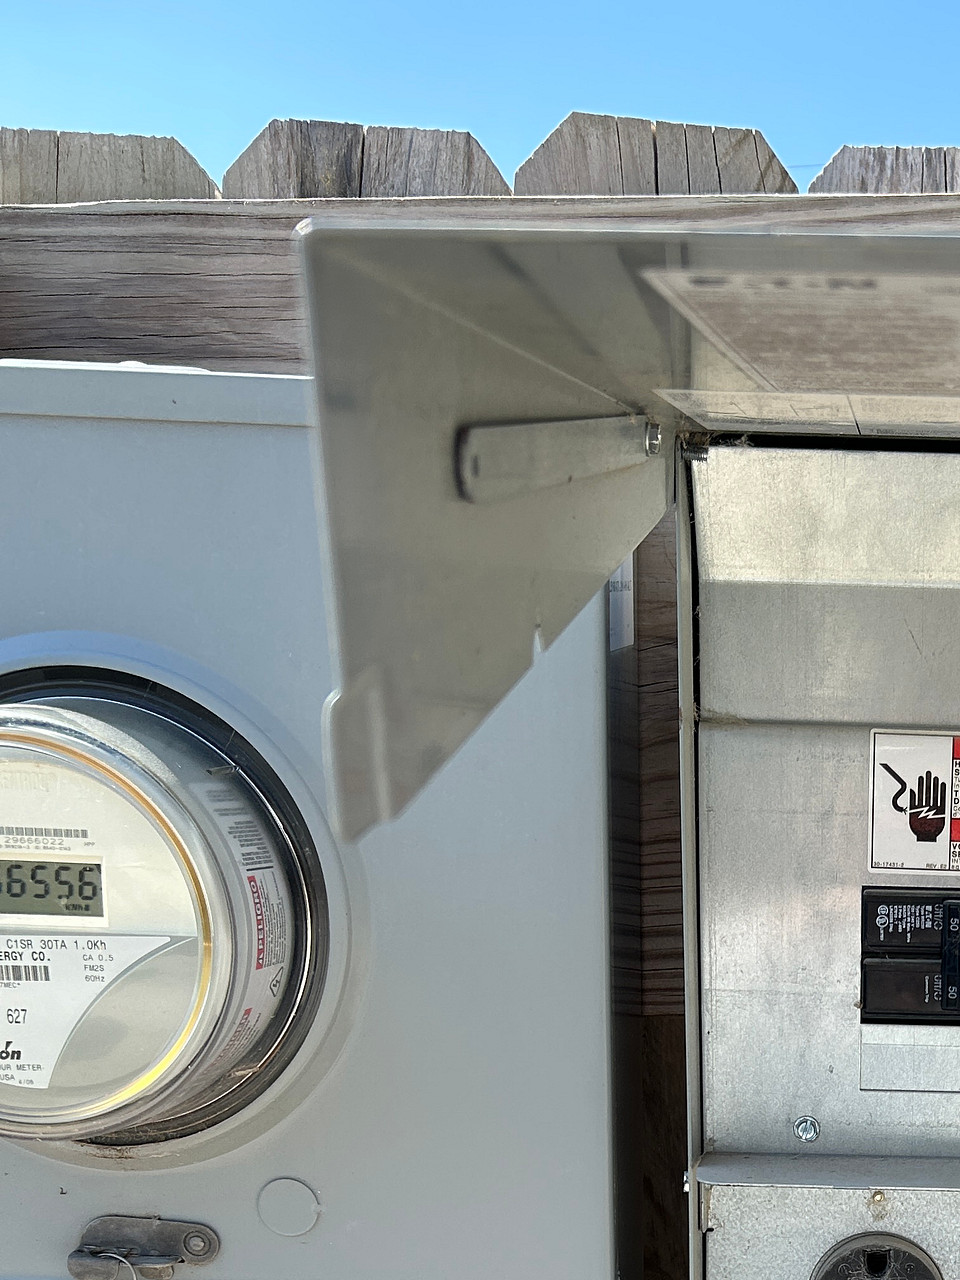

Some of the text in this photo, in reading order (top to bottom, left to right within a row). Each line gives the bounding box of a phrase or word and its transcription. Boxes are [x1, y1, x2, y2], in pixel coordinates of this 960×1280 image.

[0, 864, 97, 901] 6556
[249, 880, 265, 950] PELIGRO
[949, 917, 960, 932] 50
[6, 939, 107, 950] C1SR 30TA 1.0Kh
[32, 951, 51, 961] CO.
[98, 954, 114, 962] 0.5
[84, 964, 105, 972] FM2S
[948, 986, 957, 999] 50
[6, 1008, 27, 1024] 627
